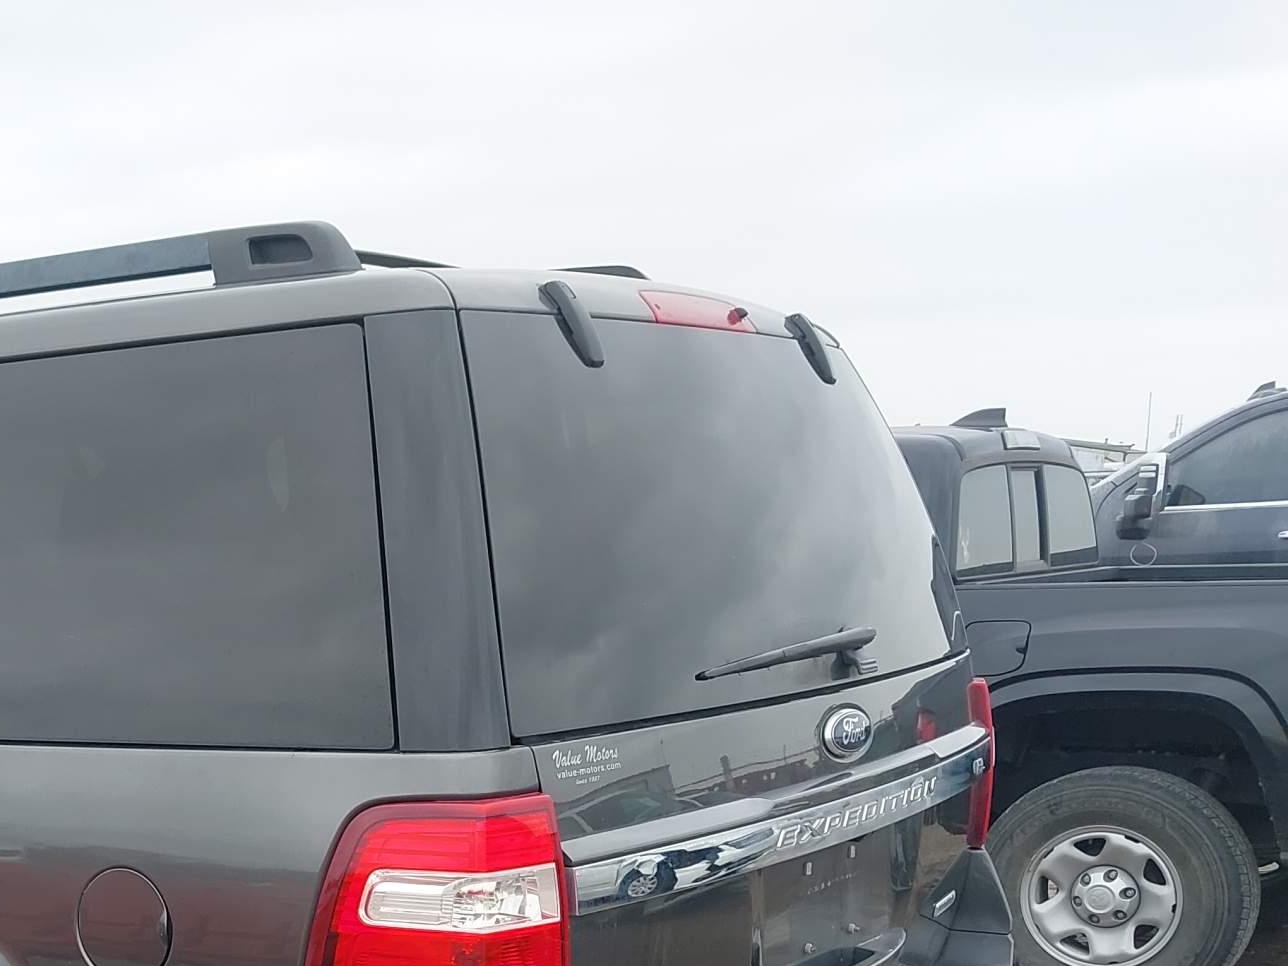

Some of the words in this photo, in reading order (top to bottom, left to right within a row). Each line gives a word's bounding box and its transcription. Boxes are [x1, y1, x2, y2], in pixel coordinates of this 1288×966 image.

[842, 716, 869, 746] Ford
[552, 749, 583, 769] Value
[584, 744, 618, 763] Motors
[776, 775, 938, 849] EXPEDITION
